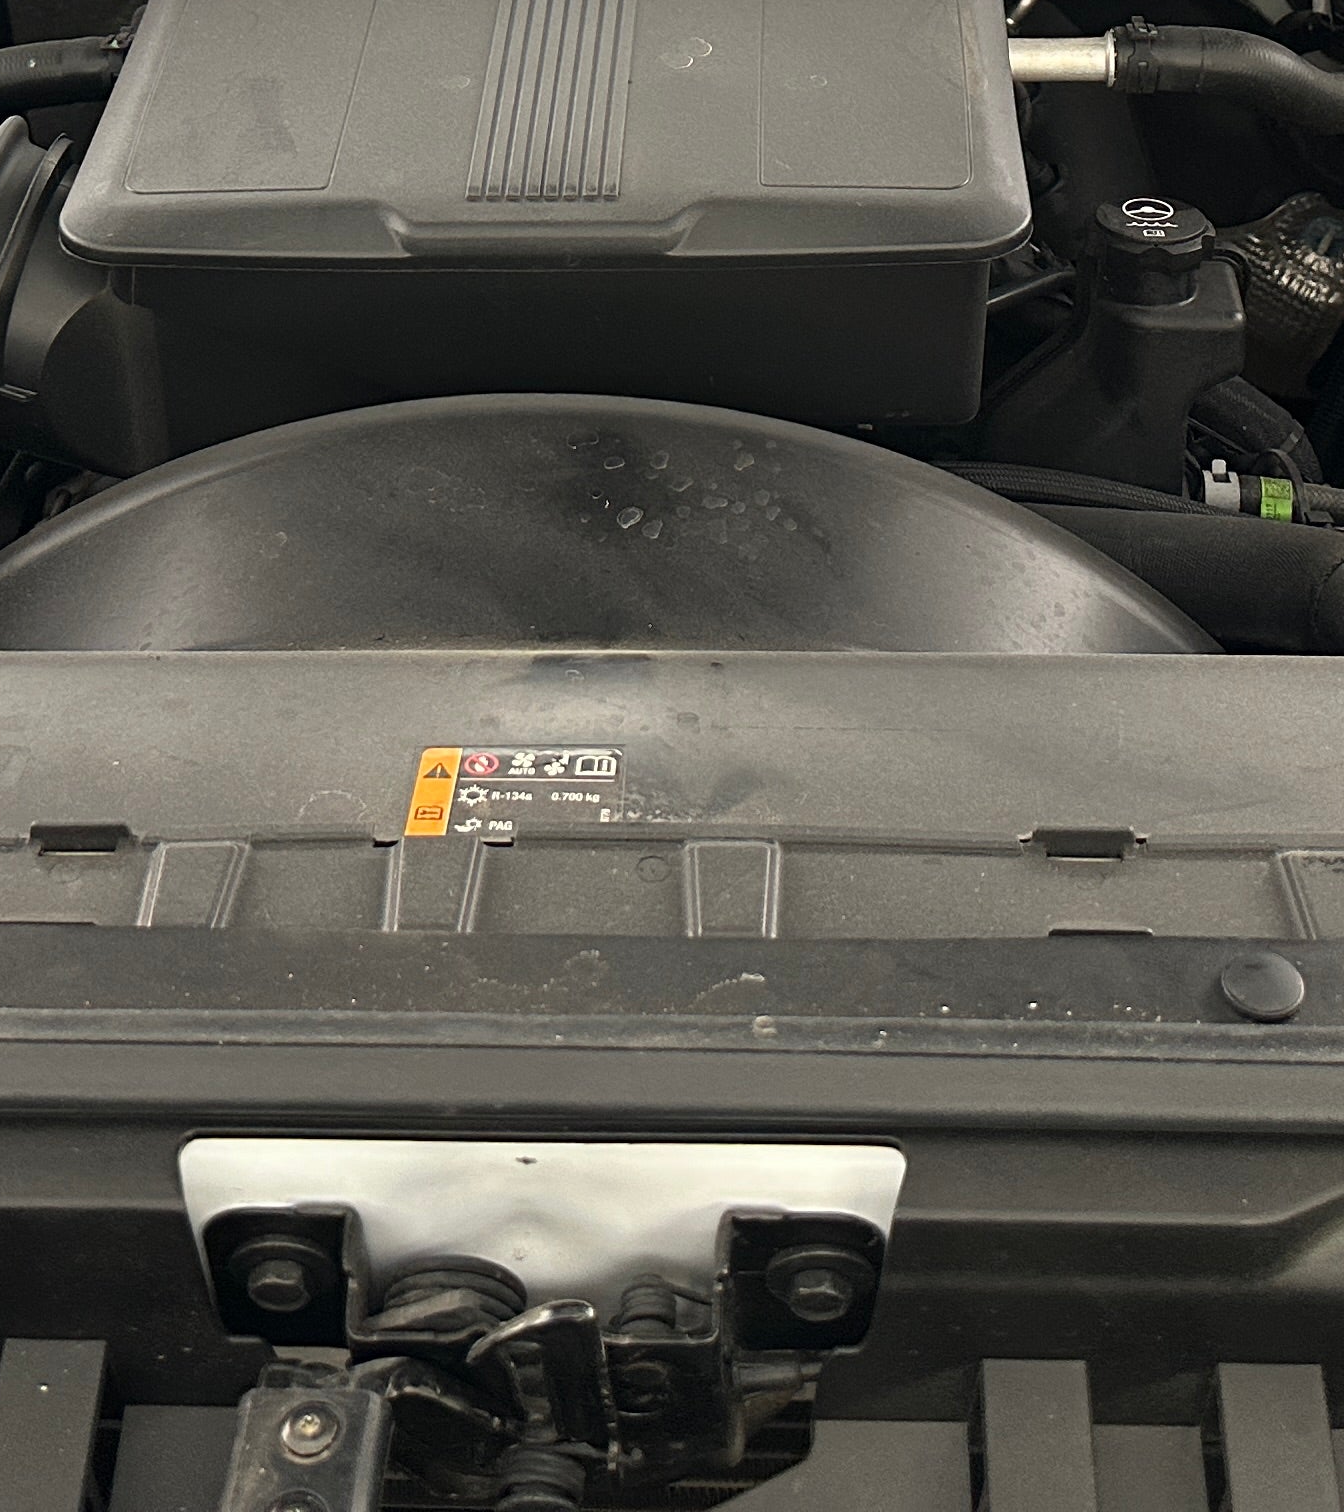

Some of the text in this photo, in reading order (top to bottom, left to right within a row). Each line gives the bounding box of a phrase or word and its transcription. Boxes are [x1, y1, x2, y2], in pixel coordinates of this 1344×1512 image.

[508, 767, 536, 775] AUTO
[491, 790, 601, 803] R-134a 0.700 kg
[488, 820, 513, 831] PAG
